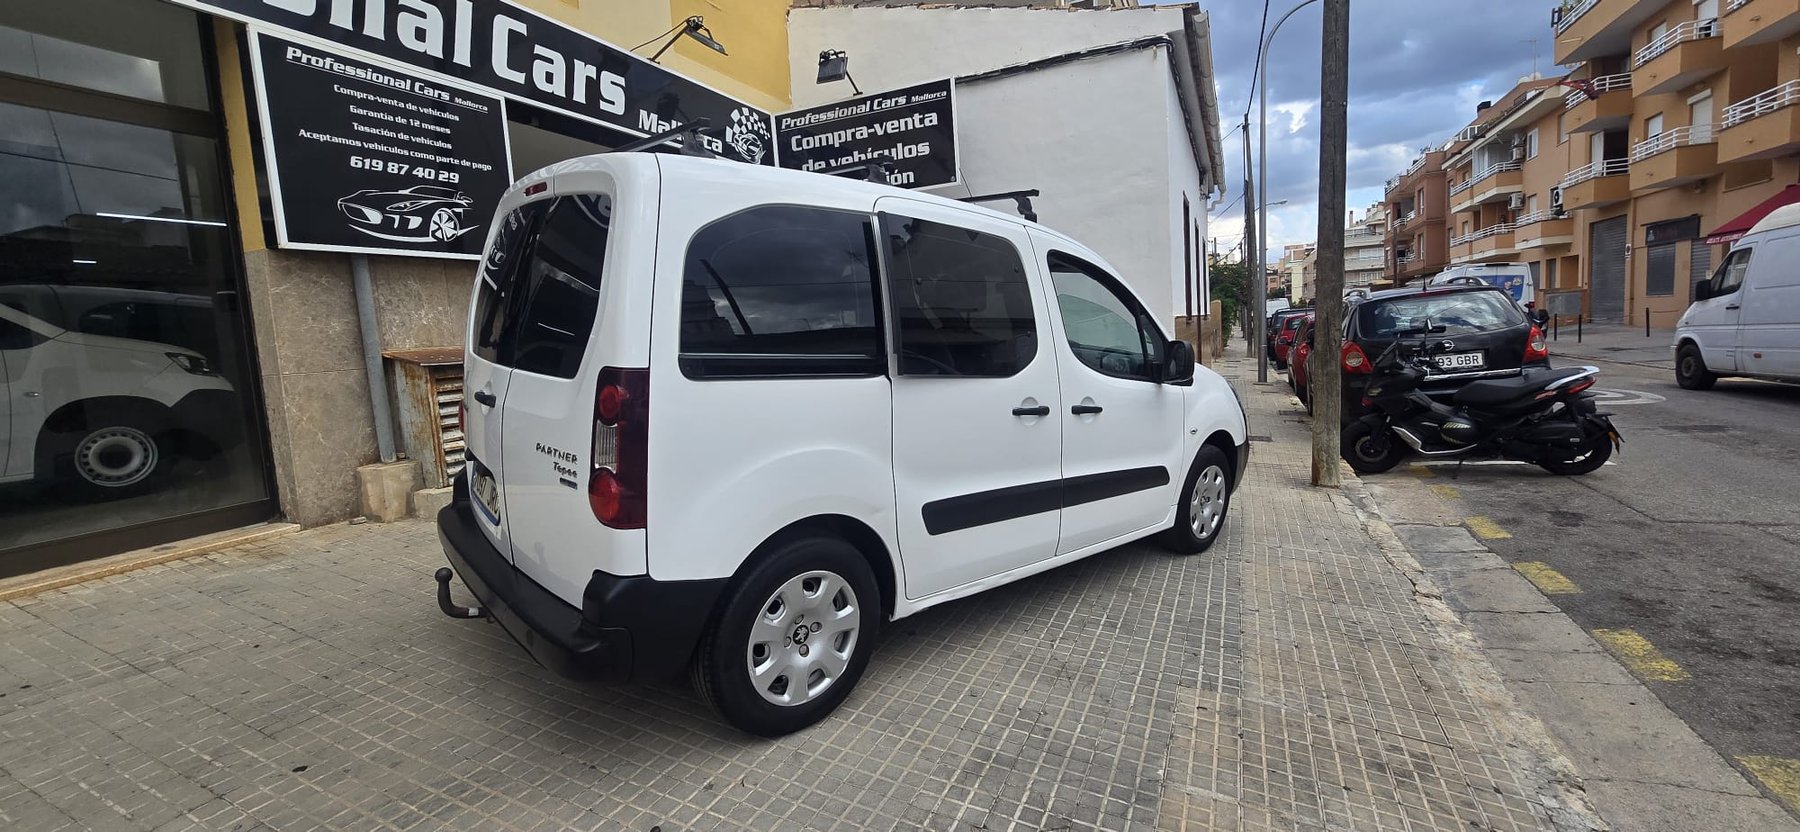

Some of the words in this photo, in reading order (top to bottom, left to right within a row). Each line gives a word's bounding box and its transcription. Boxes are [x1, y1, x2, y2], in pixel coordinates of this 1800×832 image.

[286, 46, 411, 91] Professional
[414, 81, 450, 101] Cars
[454, 96, 488, 111] Mallorca
[491, 14, 627, 116] Cars
[638, 109, 722, 154] Maca
[334, 84, 405, 108] Compra-venta
[405, 102, 418, 111] de
[781, 101, 870, 129] Professional
[873, 95, 907, 114] Cars
[911, 90, 947, 103] Mallorca
[352, 122, 397, 138] Tasación
[397, 132, 410, 141] de
[395, 115, 408, 124] de
[409, 118, 421, 127] 12
[421, 122, 451, 134] meses
[790, 112, 939, 152] Compra-venta
[298, 128, 362, 147] Aceptamos
[410, 150, 435, 160] como
[436, 155, 460, 166] parte
[460, 159, 471, 168] de
[472, 161, 492, 171] pago
[350, 155, 384, 171] 619
[387, 161, 410, 175] 87
[412, 166, 435, 180] 40
[438, 170, 460, 184] 29
[1437, 356, 1453, 367] 93
[1456, 354, 1480, 366] GBR
[535, 442, 578, 465] PARTNER
[553, 461, 578, 478] Tepee
